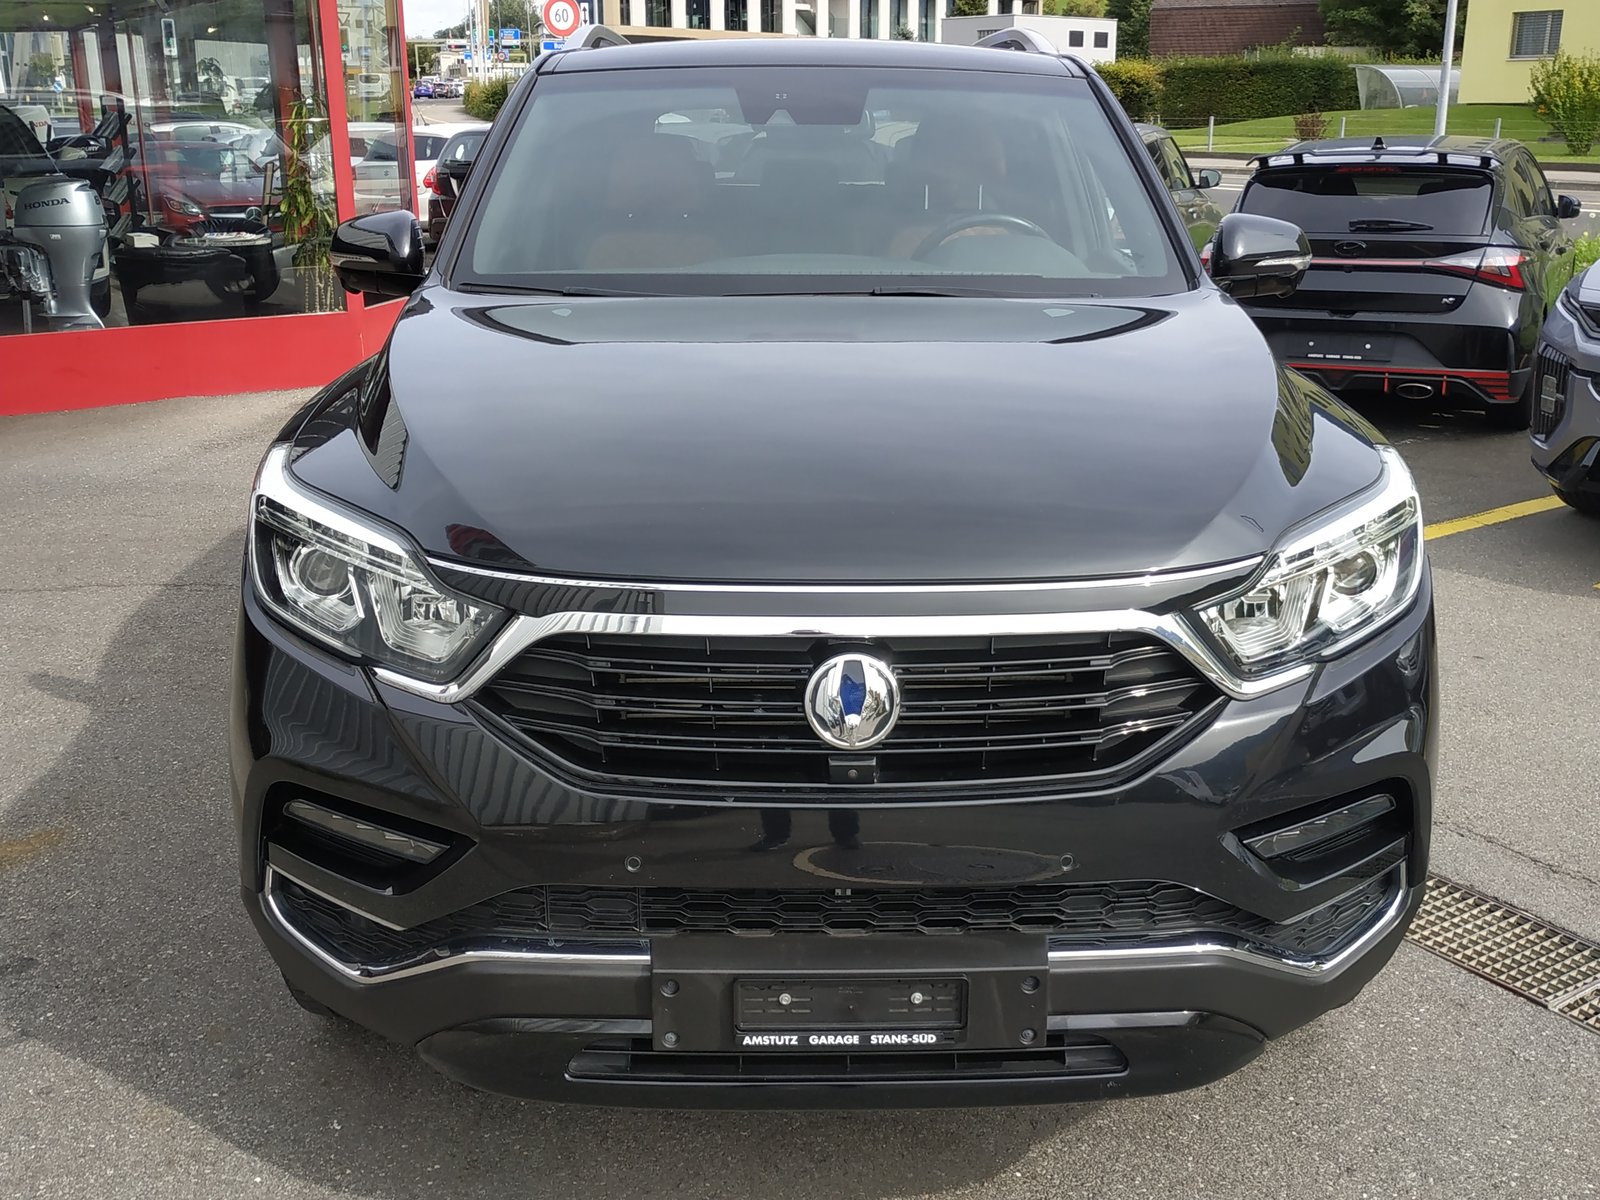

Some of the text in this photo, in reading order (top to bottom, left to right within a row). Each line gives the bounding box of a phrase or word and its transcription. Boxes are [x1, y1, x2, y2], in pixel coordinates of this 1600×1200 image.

[554, 8, 569, 23] 60
[23, 197, 71, 211] HONDA
[742, 1033, 937, 1046] AMSTUTZ GARAGE STANS-SÜD
